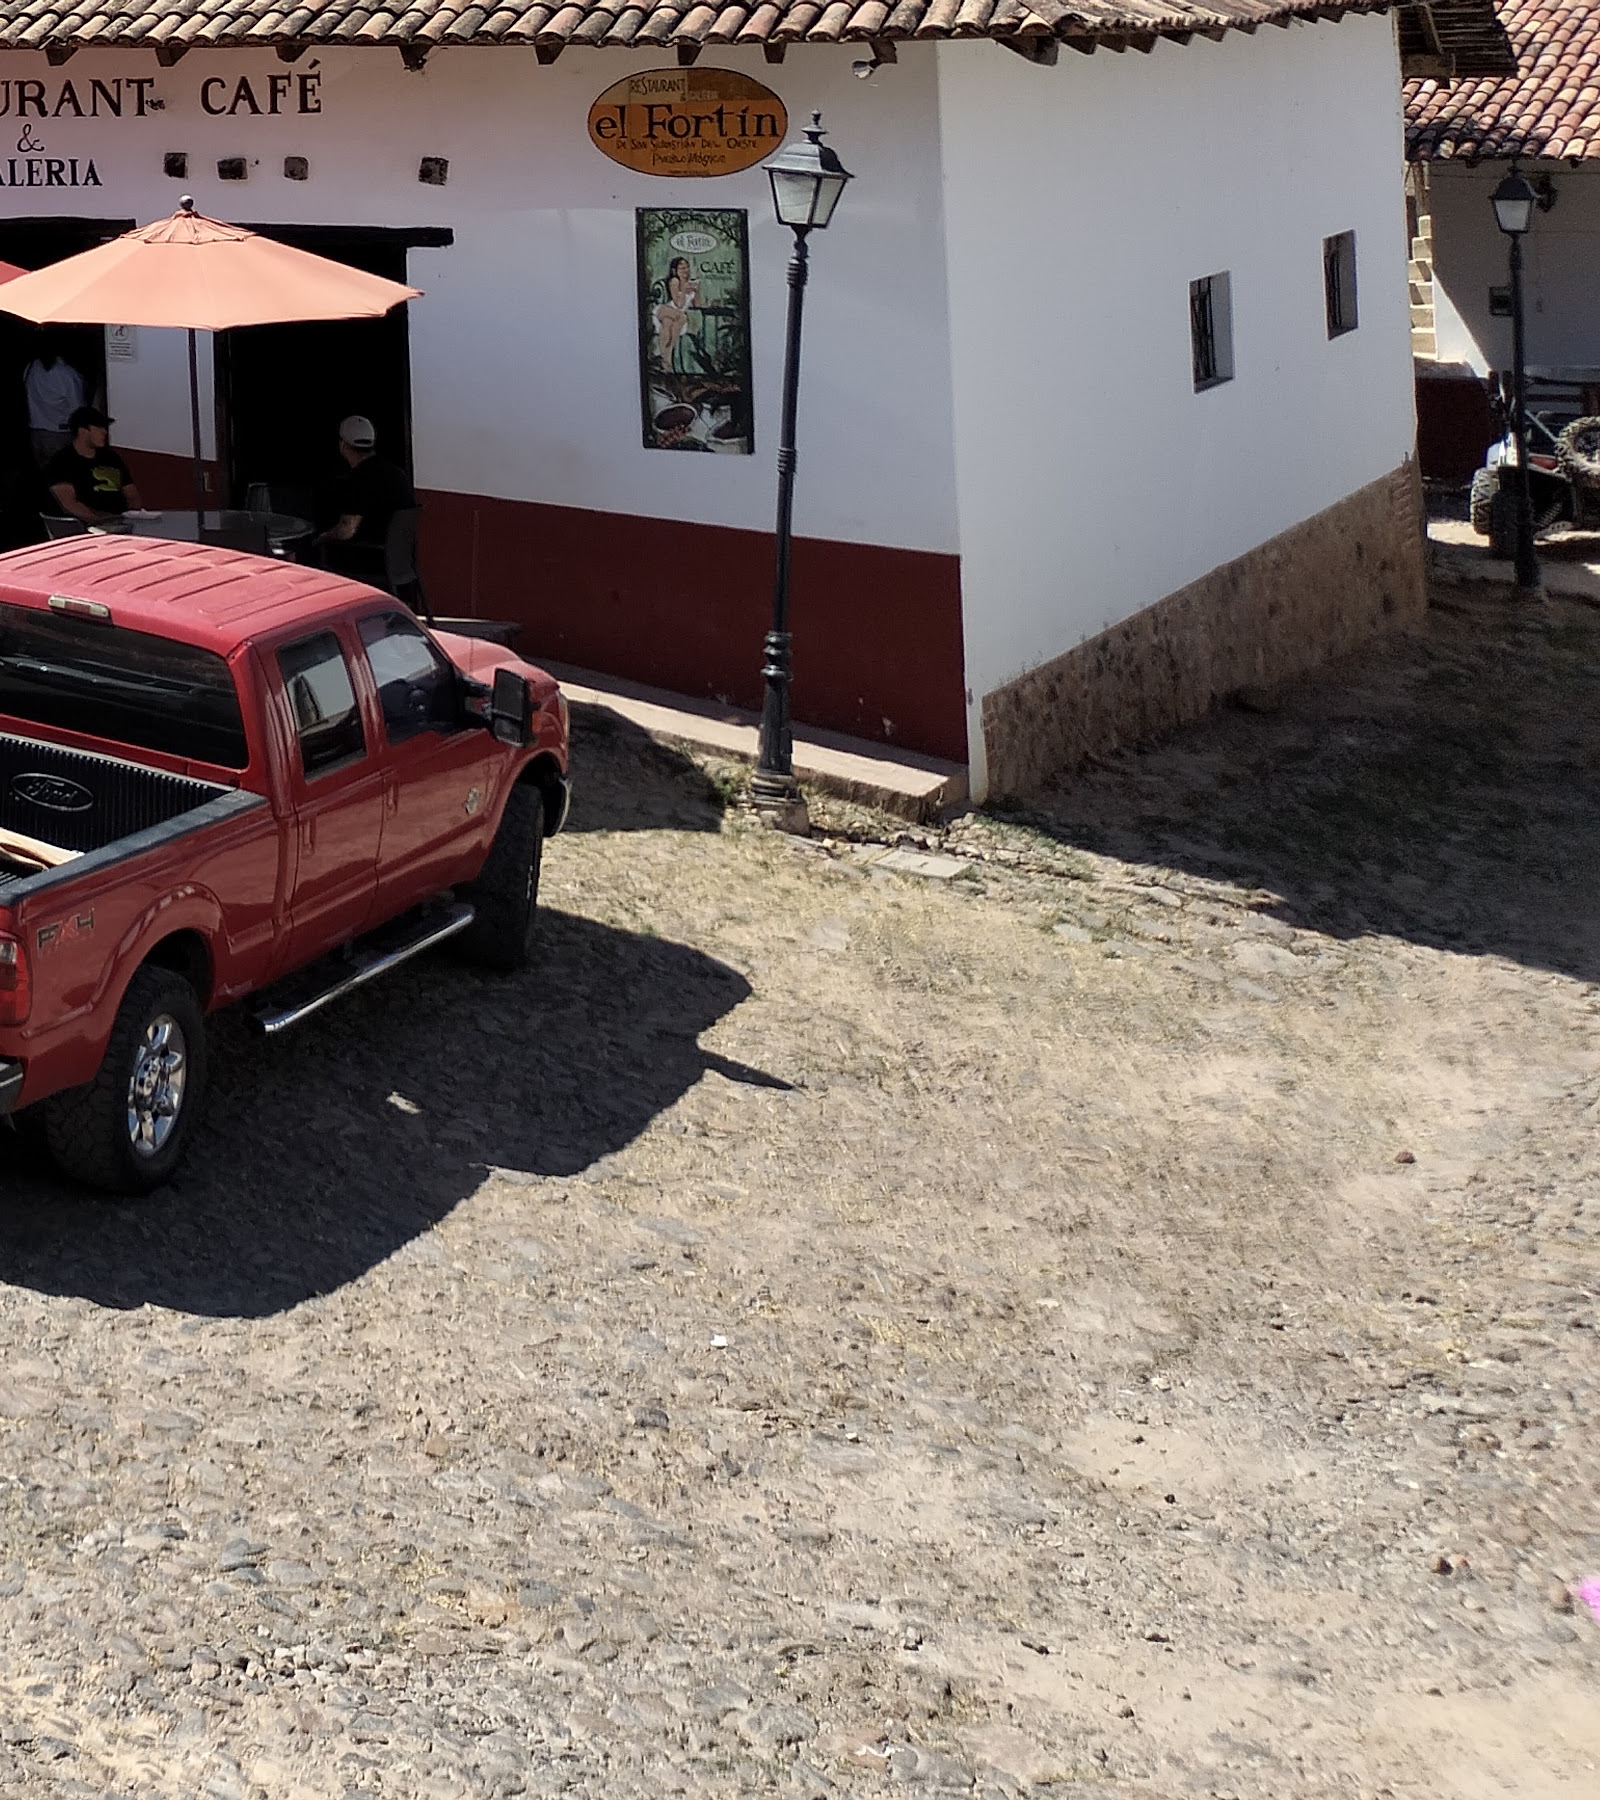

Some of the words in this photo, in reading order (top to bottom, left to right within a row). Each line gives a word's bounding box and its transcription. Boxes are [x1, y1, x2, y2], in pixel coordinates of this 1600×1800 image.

[199, 58, 324, 117] CAFÉ
[629, 77, 686, 96] RESTAURANT
[595, 105, 629, 139] el
[16, 123, 46, 153] &
[700, 260, 736, 274] CAFÉ
